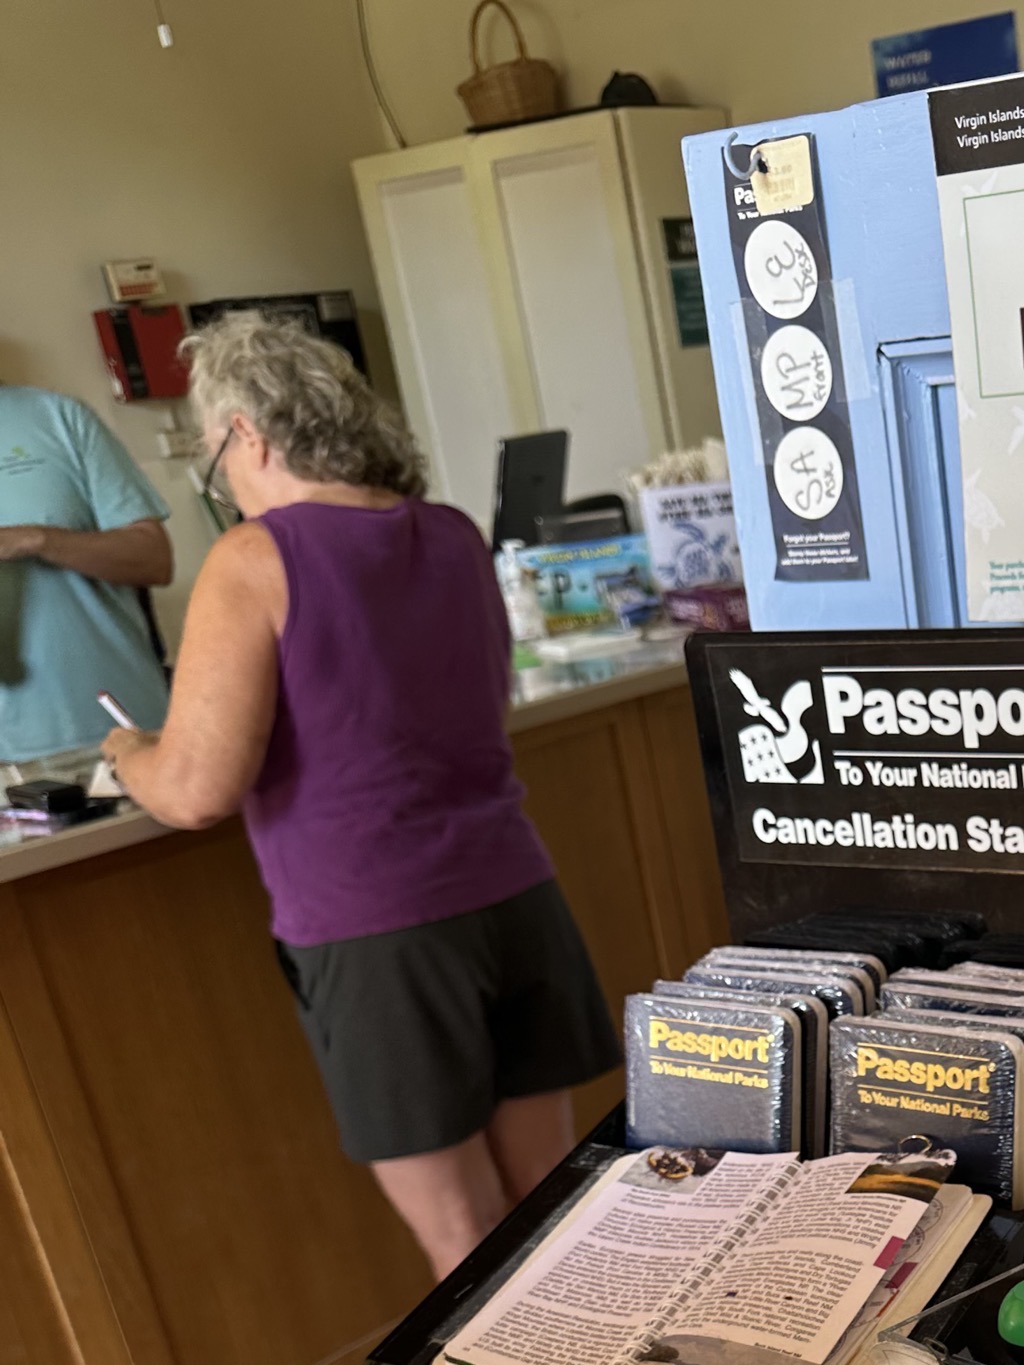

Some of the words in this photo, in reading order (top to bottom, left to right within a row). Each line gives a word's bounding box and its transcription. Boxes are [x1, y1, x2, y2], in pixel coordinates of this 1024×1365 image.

[954, 113, 987, 130] Virgin
[957, 132, 989, 149] Virgin
[776, 352, 814, 410] MP
[790, 450, 823, 512] SA
[834, 760, 863, 787] To
[865, 760, 918, 788] Your
[921, 763, 1017, 790] National
[752, 807, 959, 852] Cancellation
[648, 1020, 770, 1064] Passport
[649, 1060, 663, 1074] To
[662, 1062, 690, 1077] Your
[690, 1065, 733, 1085] National
[734, 1071, 769, 1089] Parks
[856, 1048, 991, 1094] Passport
[858, 1089, 873, 1104] To
[872, 1091, 899, 1109] Your
[899, 1095, 950, 1118] National
[951, 1101, 989, 1122] Parks
